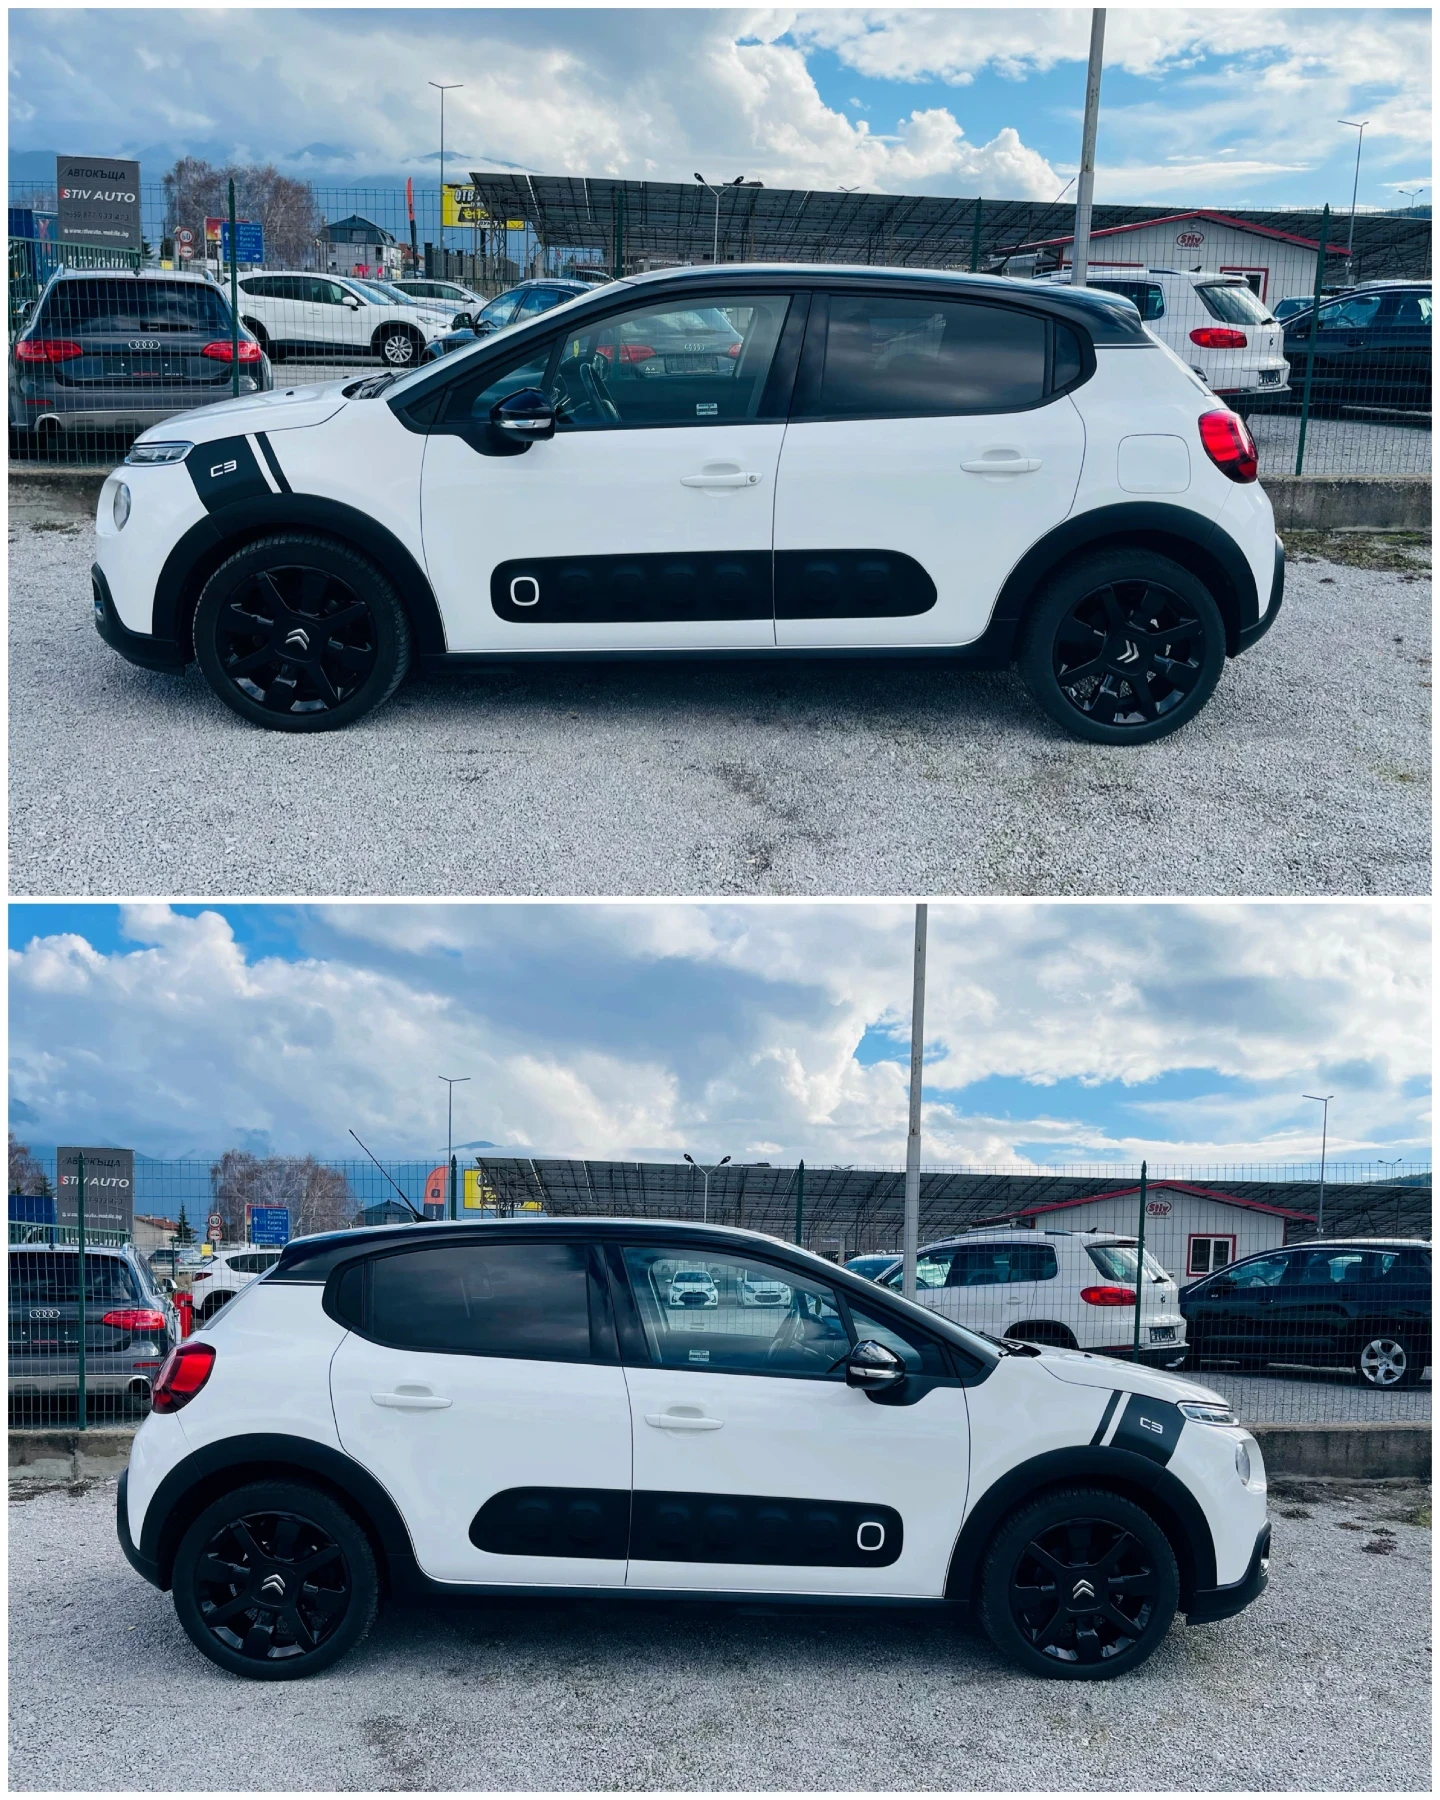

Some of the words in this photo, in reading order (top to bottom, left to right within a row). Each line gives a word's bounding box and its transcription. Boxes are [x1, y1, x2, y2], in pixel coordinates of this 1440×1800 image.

[67, 168, 126, 182] АВТОКЪЩА
[63, 188, 92, 200] STIV
[93, 190, 136, 203] AUTO
[181, 232, 191, 240] 60
[1180, 234, 1201, 244] Stiv
[210, 459, 237, 478] C3
[89, 1177, 130, 1188] AUTO
[1148, 1203, 1169, 1212] Stiv
[210, 1217, 220, 1225] 60
[1139, 1416, 1164, 1435] C3
